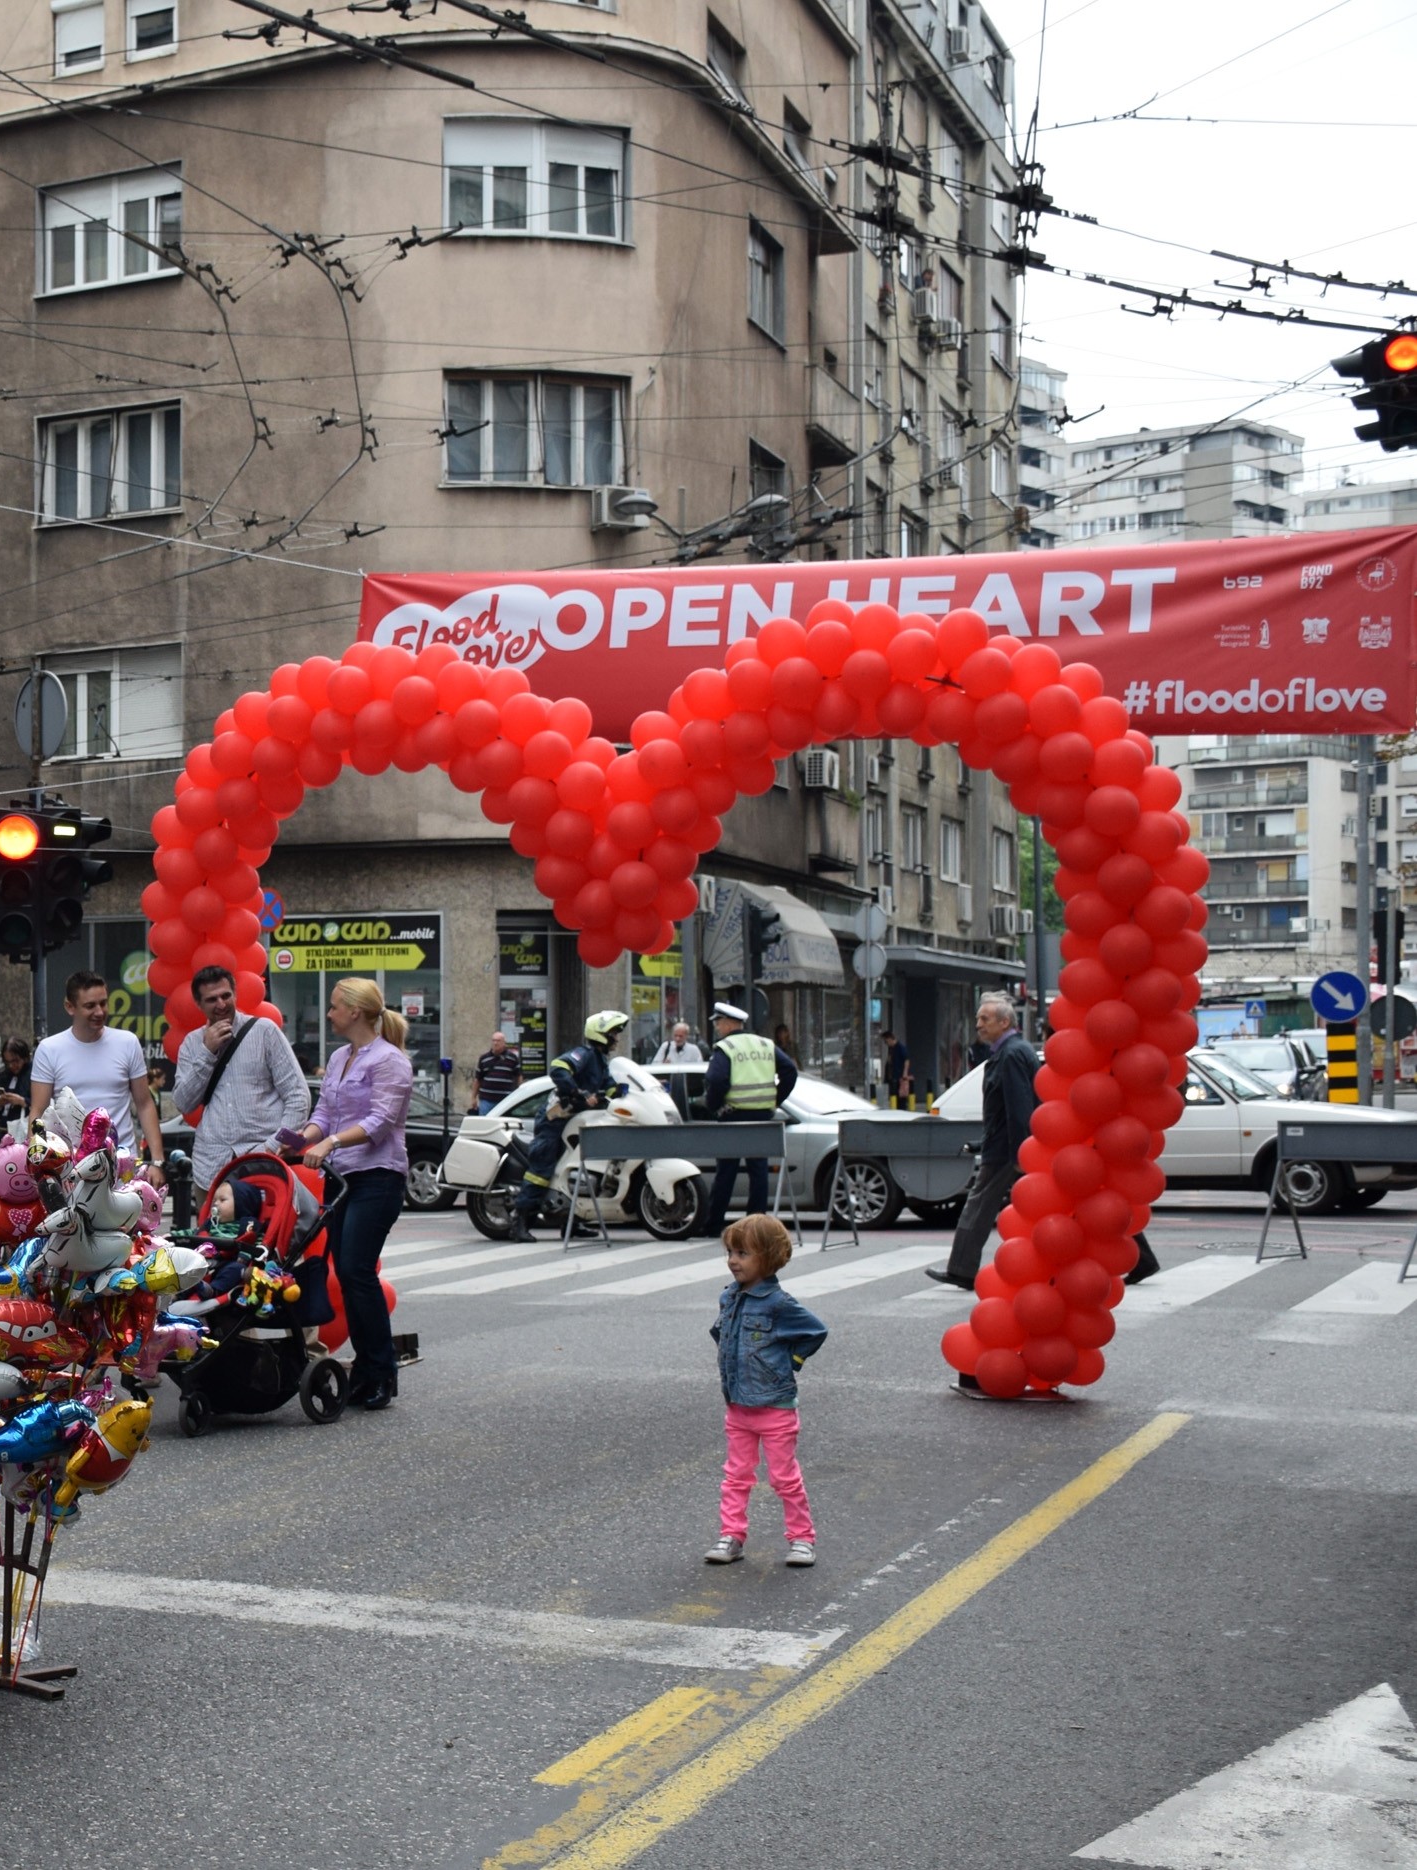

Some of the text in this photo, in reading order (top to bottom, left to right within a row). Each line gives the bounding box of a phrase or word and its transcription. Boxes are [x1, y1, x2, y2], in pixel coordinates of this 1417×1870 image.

[1300, 576, 1323, 589] B92
[1302, 564, 1333, 577] FOND
[391, 594, 501, 655] Flood
[539, 582, 793, 651] OPEN
[462, 629, 539, 672] ove
[1123, 678, 1387, 714] #floodoflove
[305, 947, 411, 957] OTKLJUČANI SMART TELEFONI
[306, 959, 317, 969] ZA
[326, 958, 354, 968] DINAR
